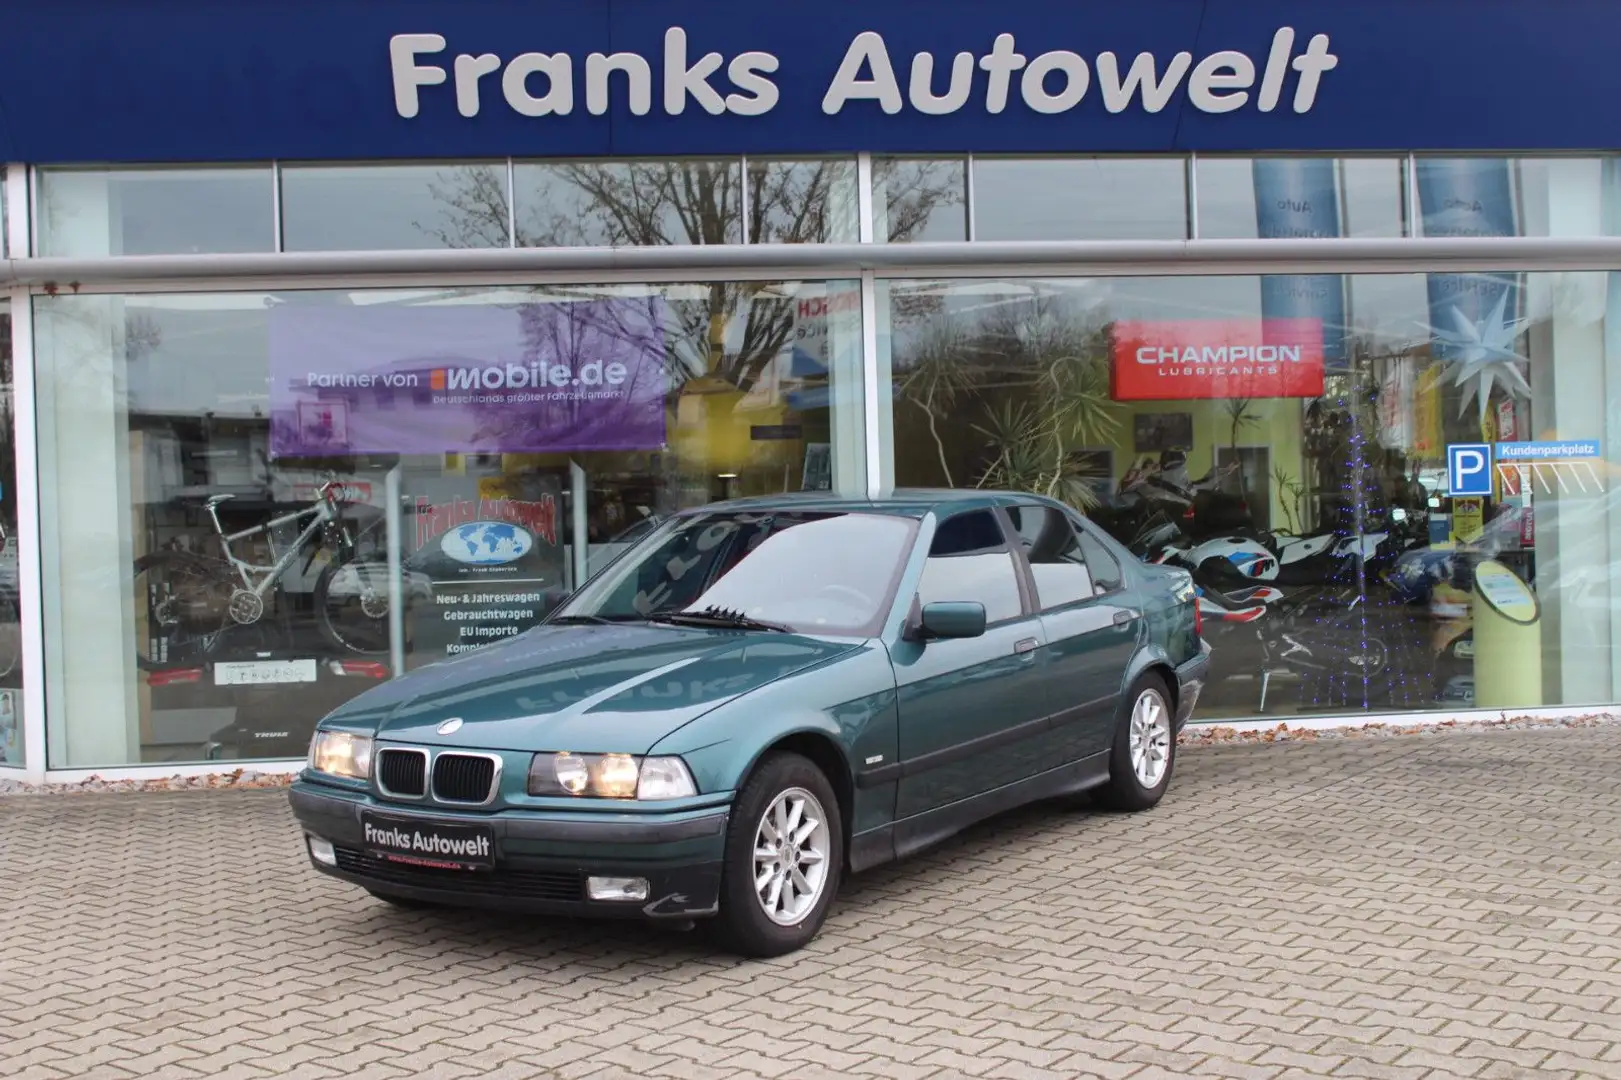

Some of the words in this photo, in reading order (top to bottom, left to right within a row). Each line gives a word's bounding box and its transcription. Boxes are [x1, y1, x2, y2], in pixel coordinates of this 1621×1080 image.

[389, 26, 779, 118] Franks
[822, 26, 1338, 115] Autowelt
[1136, 344, 1301, 364] CHAMPION
[307, 371, 379, 388] Partner
[384, 374, 418, 388] von
[448, 359, 628, 390] mobile.de
[1158, 366, 1278, 376] LUBRICANTS
[432, 393, 505, 404] Deutschlands
[506, 392, 545, 405] größter
[1501, 443, 1595, 458] Kundenparkplatz
[1455, 450, 1485, 489] P
[436, 594, 461, 604] Neu-
[463, 593, 470, 604] &
[471, 592, 540, 605] Jahreswagen
[443, 609, 534, 621] Gebrauchtwagen
[460, 626, 475, 637] EU
[475, 625, 518, 638] Importe
[364, 822, 411, 849] Franks
[412, 831, 490, 857] Autowelt
